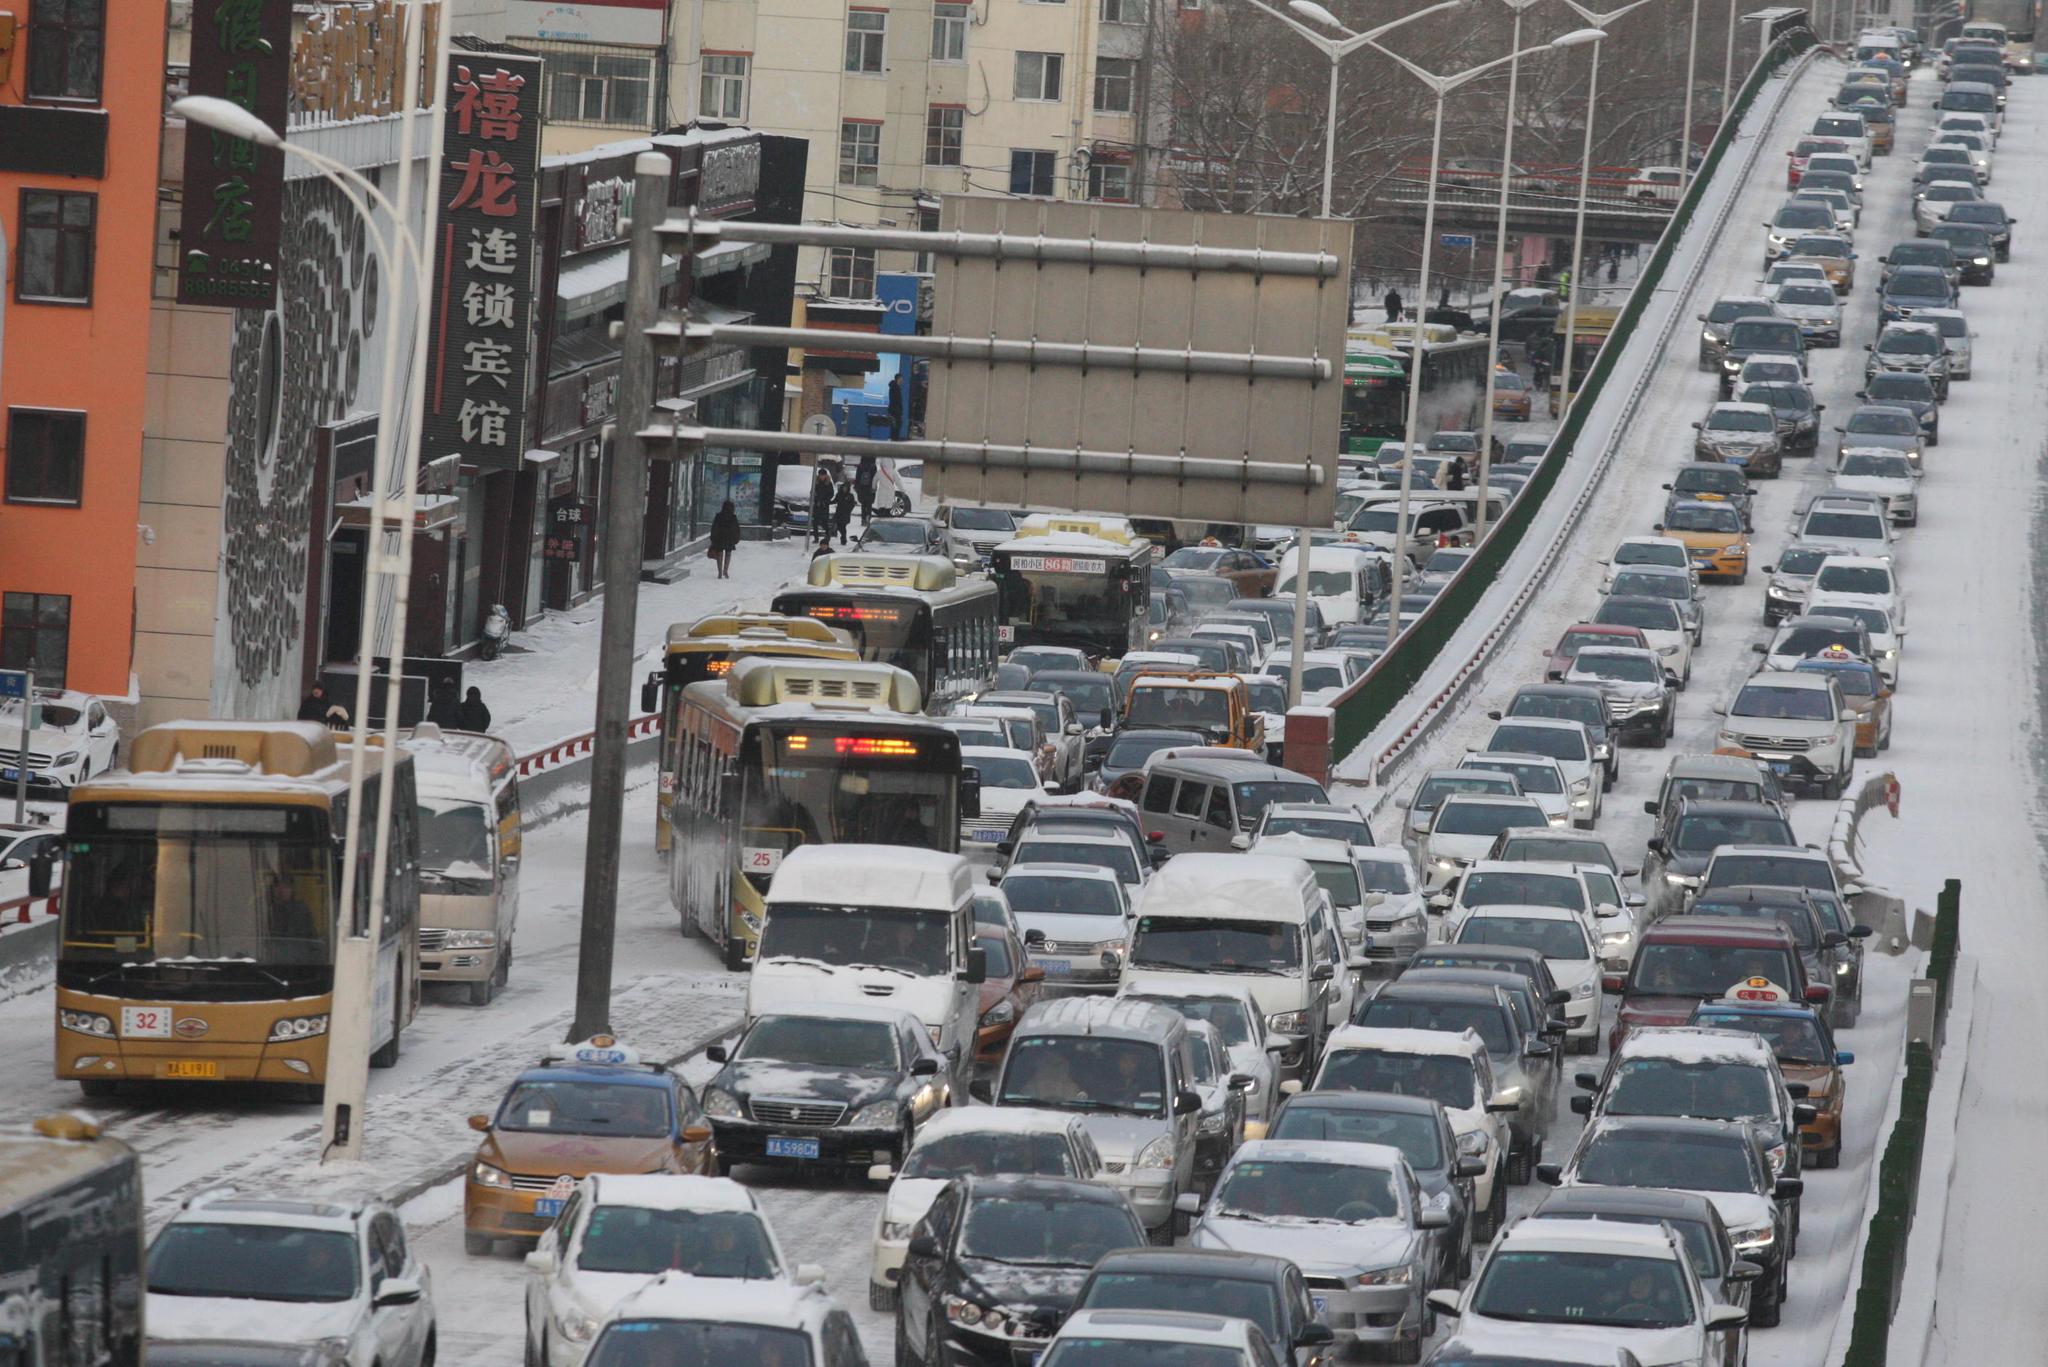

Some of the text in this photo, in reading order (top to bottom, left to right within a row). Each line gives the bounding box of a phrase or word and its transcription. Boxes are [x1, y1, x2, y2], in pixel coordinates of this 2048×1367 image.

[556, 507, 581, 522] 台球
[752, 852, 771, 866] 25
[135, 1012, 158, 1030] 32
